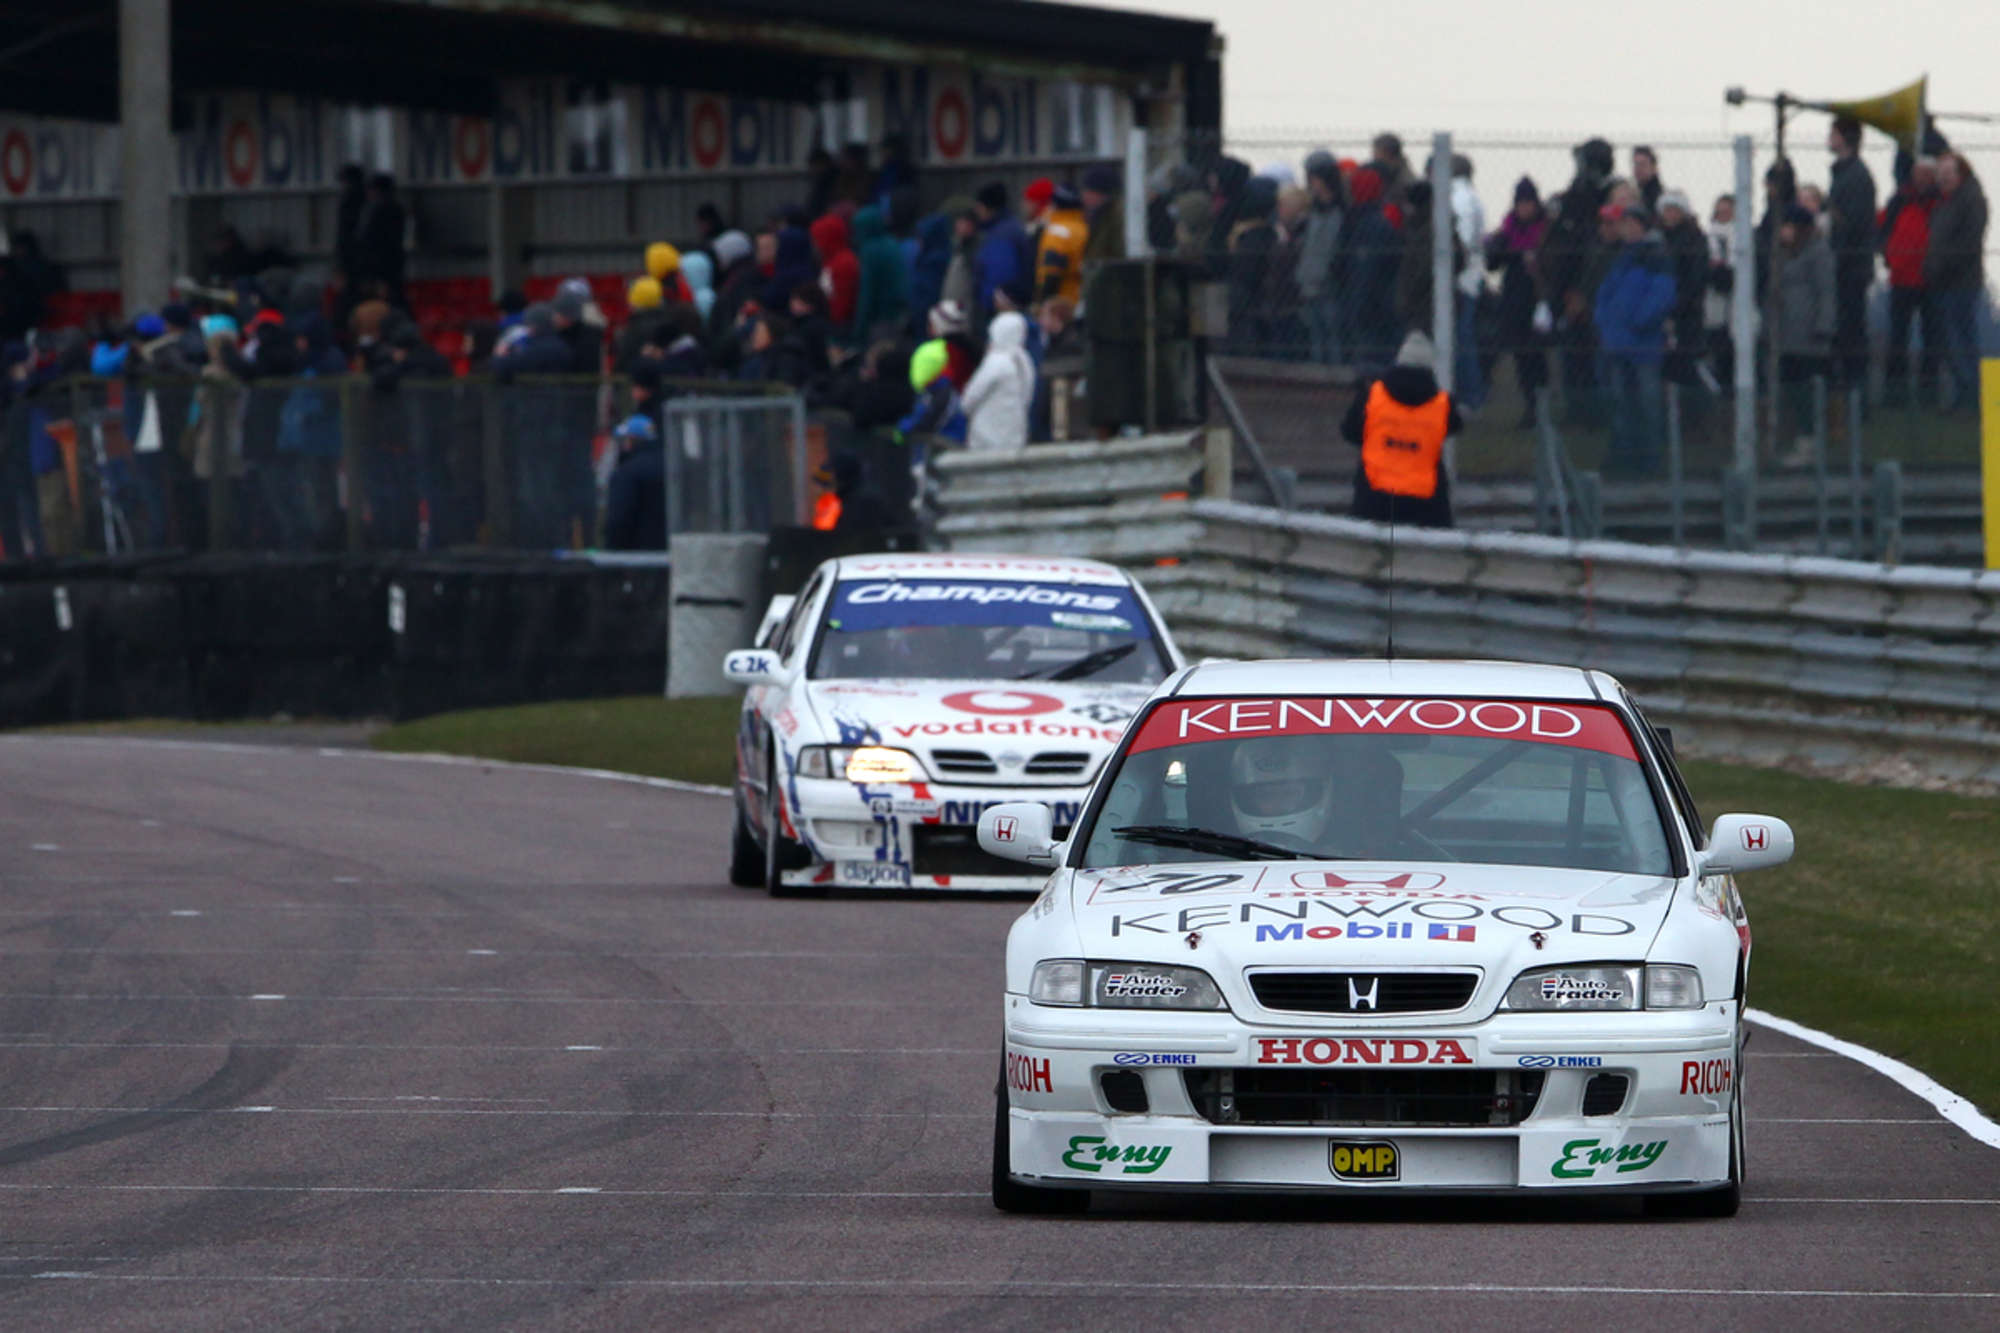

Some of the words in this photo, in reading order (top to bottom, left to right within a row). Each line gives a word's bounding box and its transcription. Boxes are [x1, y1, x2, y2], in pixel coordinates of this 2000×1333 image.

[2, 122, 95, 195] obil
[848, 583, 1121, 611] Champions
[892, 718, 1122, 744] vodafone
[1178, 699, 1582, 738] KENWOOD
[1100, 872, 1243, 895] 70
[1112, 900, 1636, 937] KENWOOD
[1256, 923, 1413, 942] Mobil
[1106, 986, 1186, 997] Trader
[1124, 974, 1173, 986] Auto
[1559, 977, 1607, 989] Auto
[1542, 989, 1622, 1000] Trader
[1153, 1054, 1197, 1065] ENKEI
[1257, 1037, 1473, 1064] HONDA
[1558, 1056, 1603, 1067] ENKEI
[1008, 1052, 1054, 1093] RICOH
[1680, 1058, 1732, 1095] RICOH
[1333, 1146, 1397, 1173] OMP
